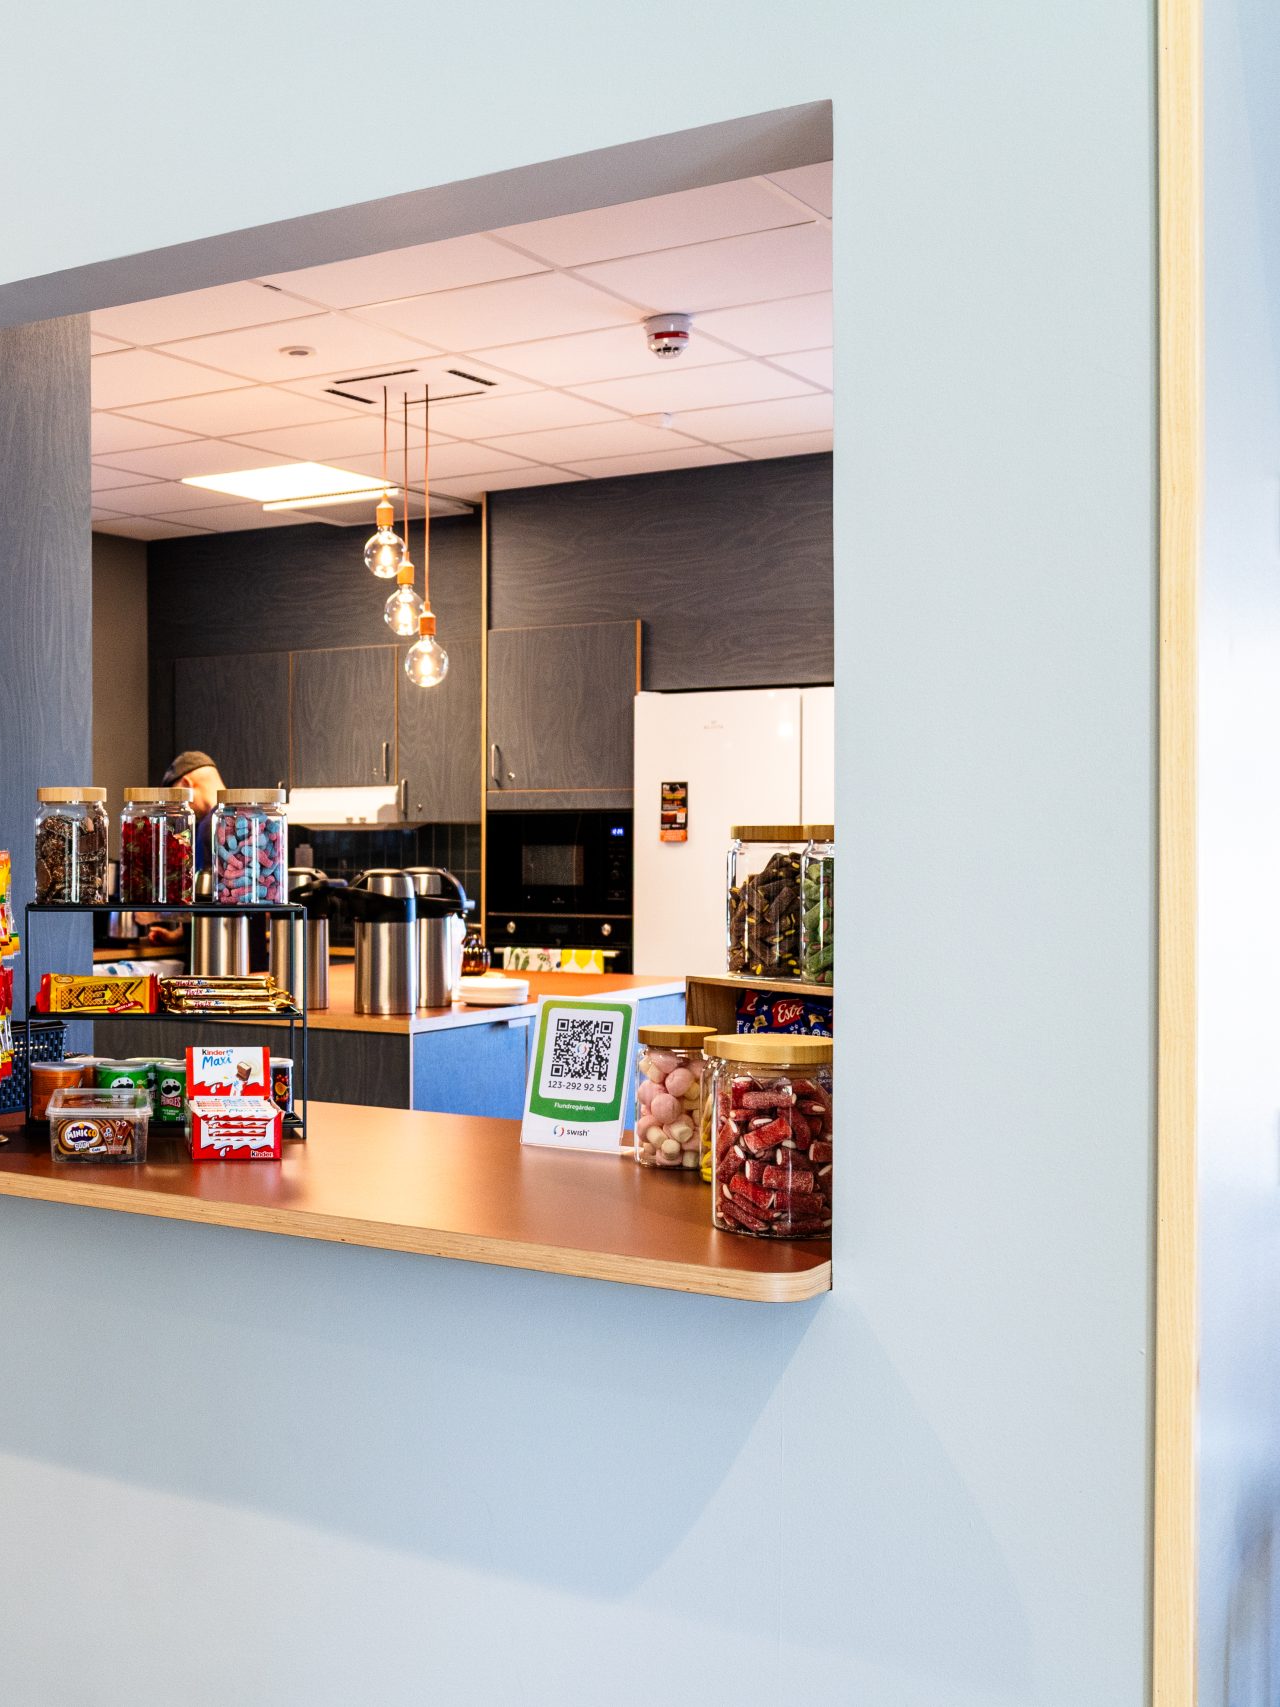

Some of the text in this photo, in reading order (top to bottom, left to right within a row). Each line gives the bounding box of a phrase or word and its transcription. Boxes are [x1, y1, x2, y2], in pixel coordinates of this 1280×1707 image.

[60, 982, 135, 1010] KEX
[201, 1048, 226, 1056] Kinder
[202, 1055, 232, 1070] Maxi
[547, 1080, 607, 1093] 123-292 92 55
[553, 1102, 596, 1111] Flundregården
